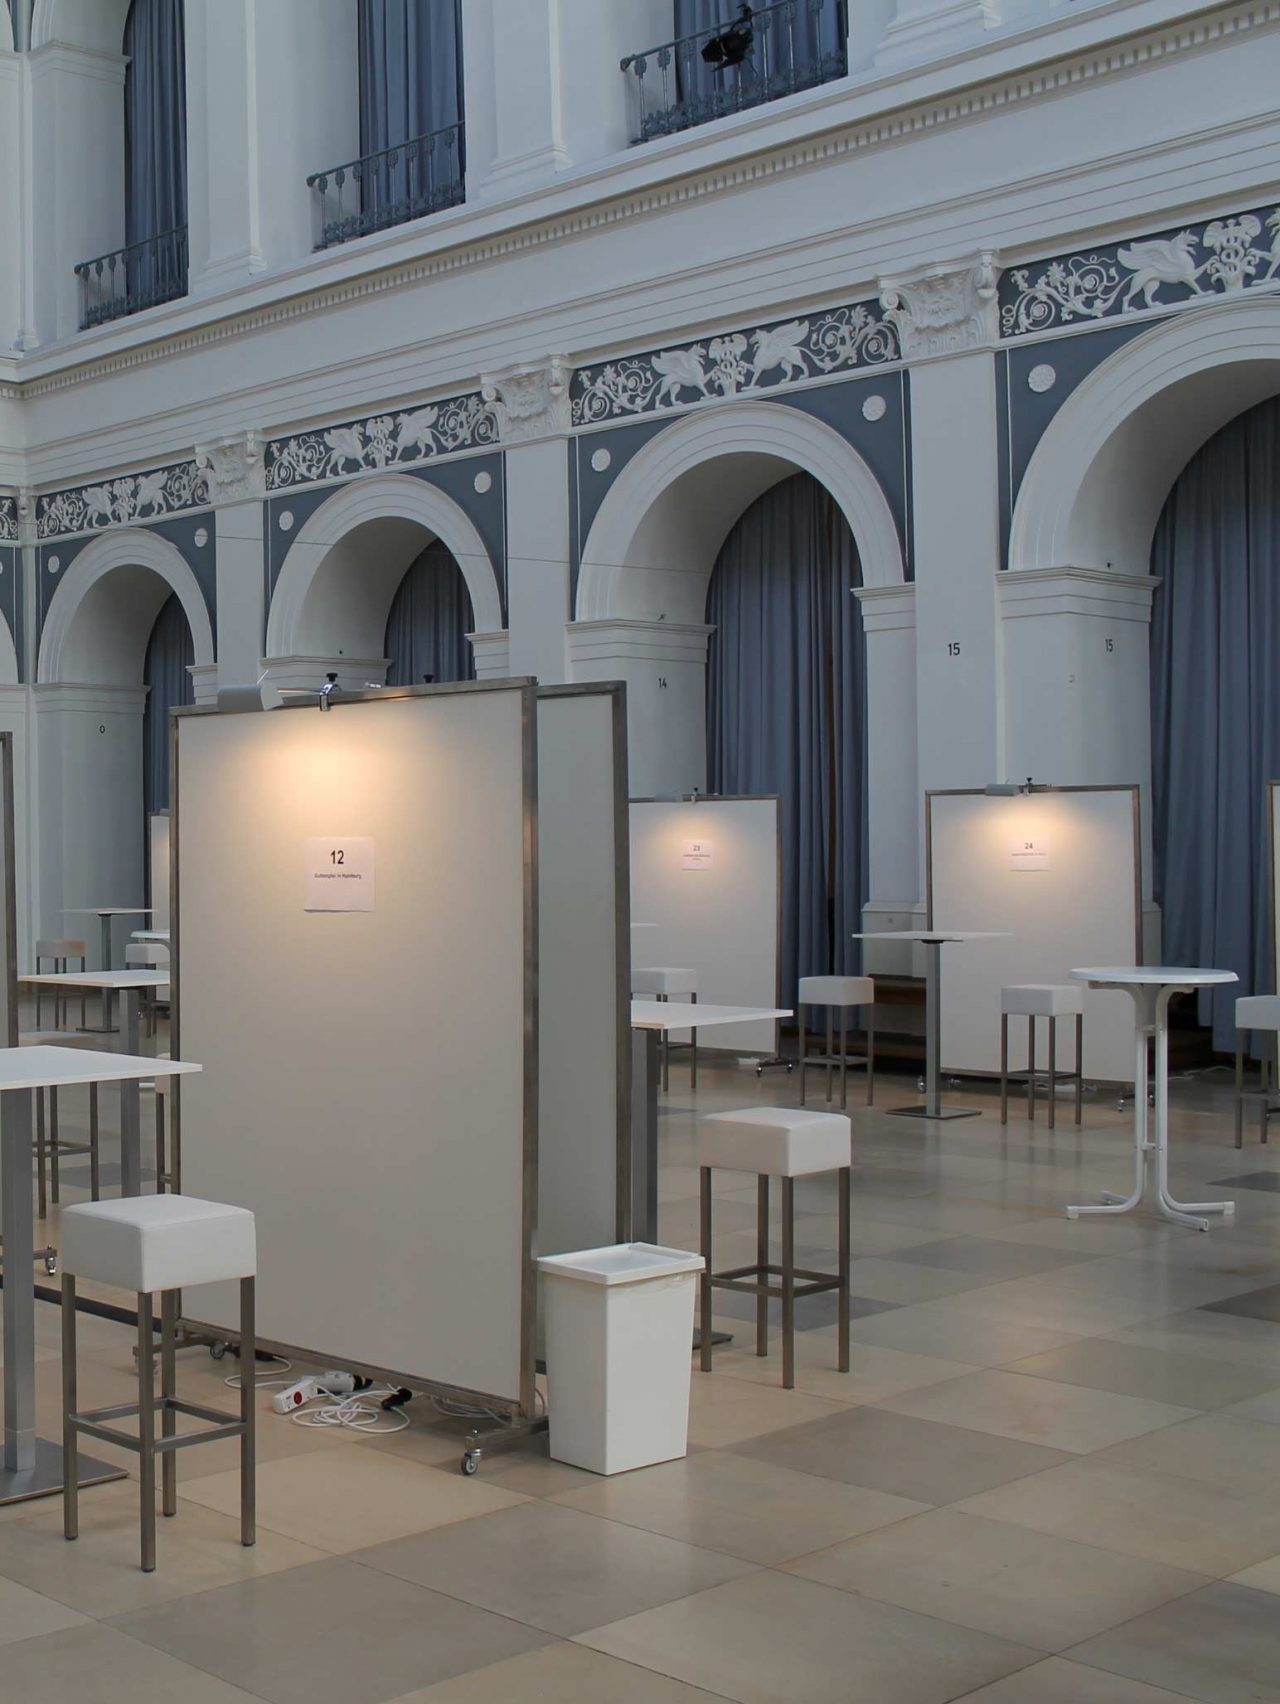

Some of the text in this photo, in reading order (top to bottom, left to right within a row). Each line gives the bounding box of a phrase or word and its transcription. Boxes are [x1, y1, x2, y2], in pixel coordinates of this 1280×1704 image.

[948, 642, 960, 656] 15
[1105, 639, 1114, 652] 15
[658, 677, 667, 689] 14
[330, 849, 345, 865] 12
